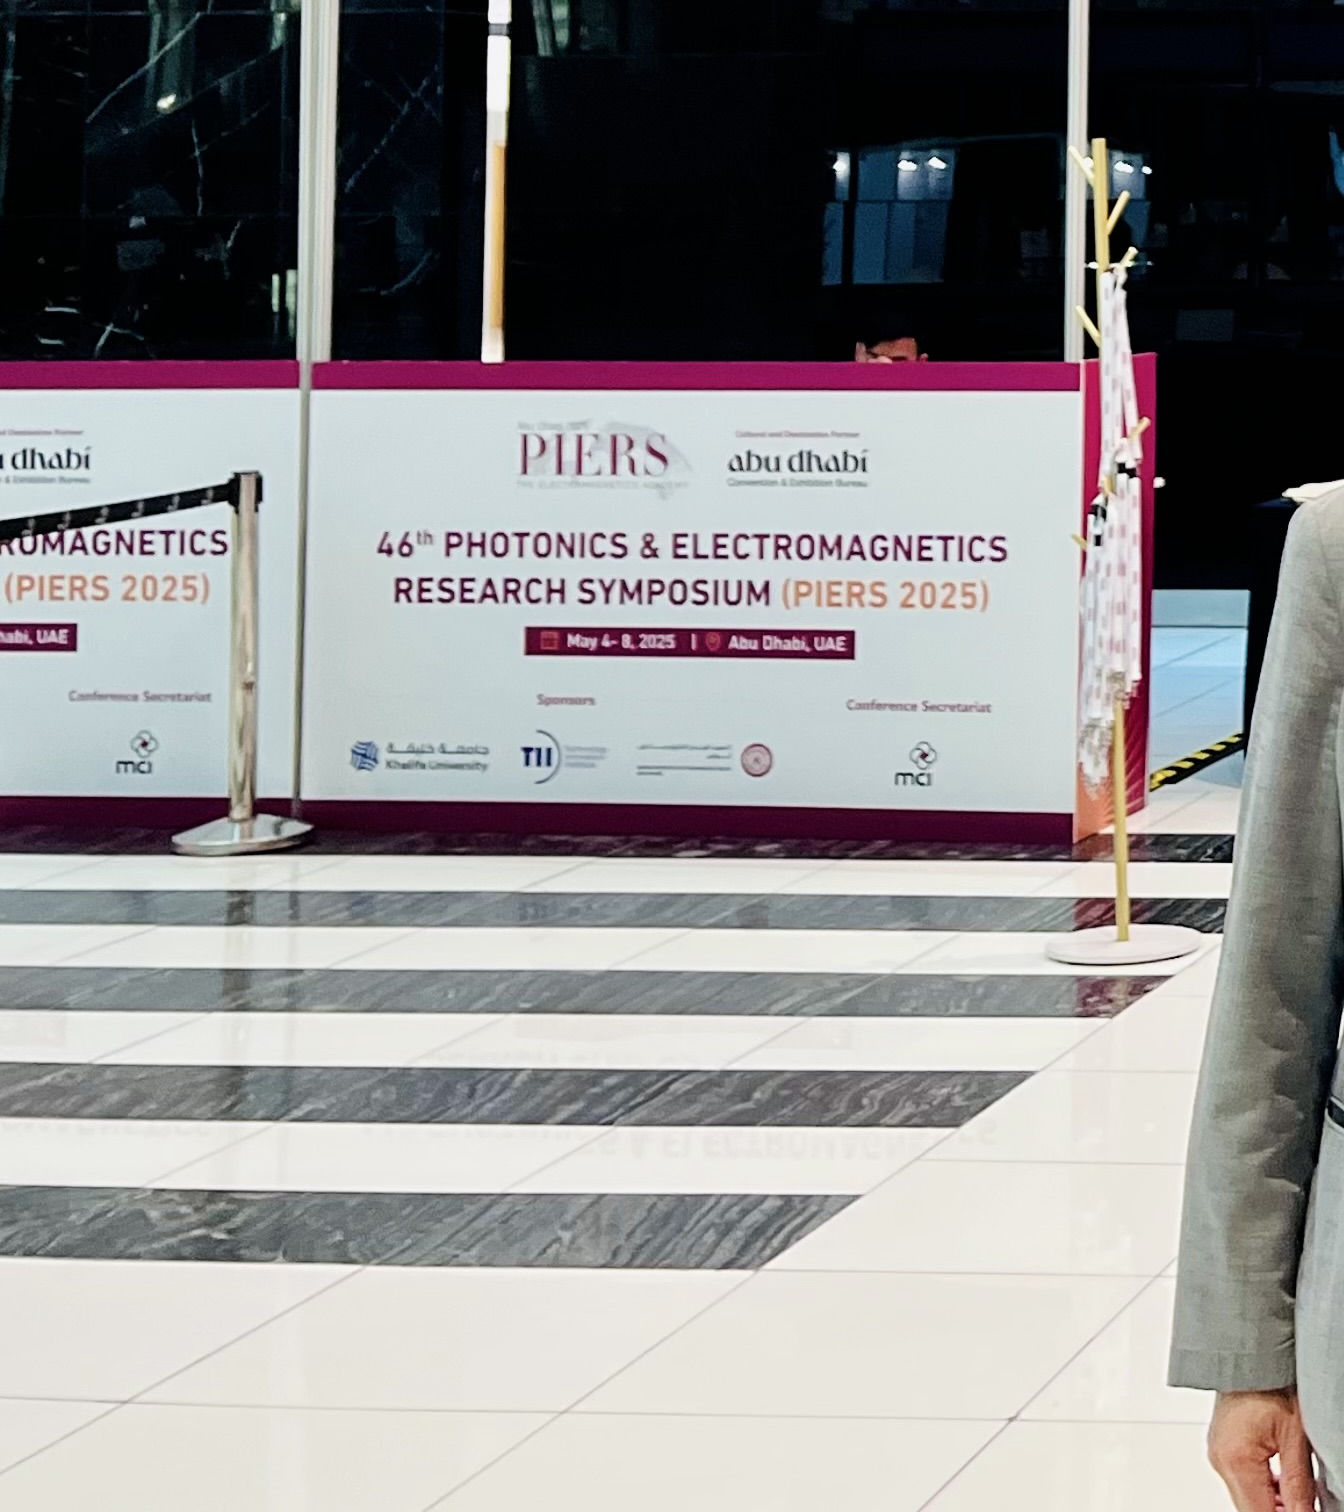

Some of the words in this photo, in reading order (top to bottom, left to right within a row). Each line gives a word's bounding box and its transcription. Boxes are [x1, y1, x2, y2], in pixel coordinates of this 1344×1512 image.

[518, 433, 669, 477] PIERS
[727, 449, 781, 473] abu
[376, 529, 434, 558] 46th
[444, 531, 628, 559] PHOTONICS
[639, 532, 659, 559] &
[671, 533, 1009, 563] ELECTROMAGNETICS
[4, 572, 110, 604] (PIERS
[121, 572, 210, 605] 2025)
[394, 577, 566, 604] RESEARCH
[577, 578, 770, 606] SYMPOSIUM
[782, 578, 888, 610] (PIERS
[899, 579, 990, 612] 2025)
[36, 628, 69, 645] UAE
[566, 632, 597, 651] May
[639, 633, 676, 650] 2025
[728, 634, 758, 650] Abu
[813, 635, 847, 652] UAE
[536, 693, 596, 707] Sponsors
[846, 698, 918, 713] Conference
[921, 699, 992, 714] Secretariat
[520, 746, 552, 768] TII
[894, 771, 933, 787] mci
